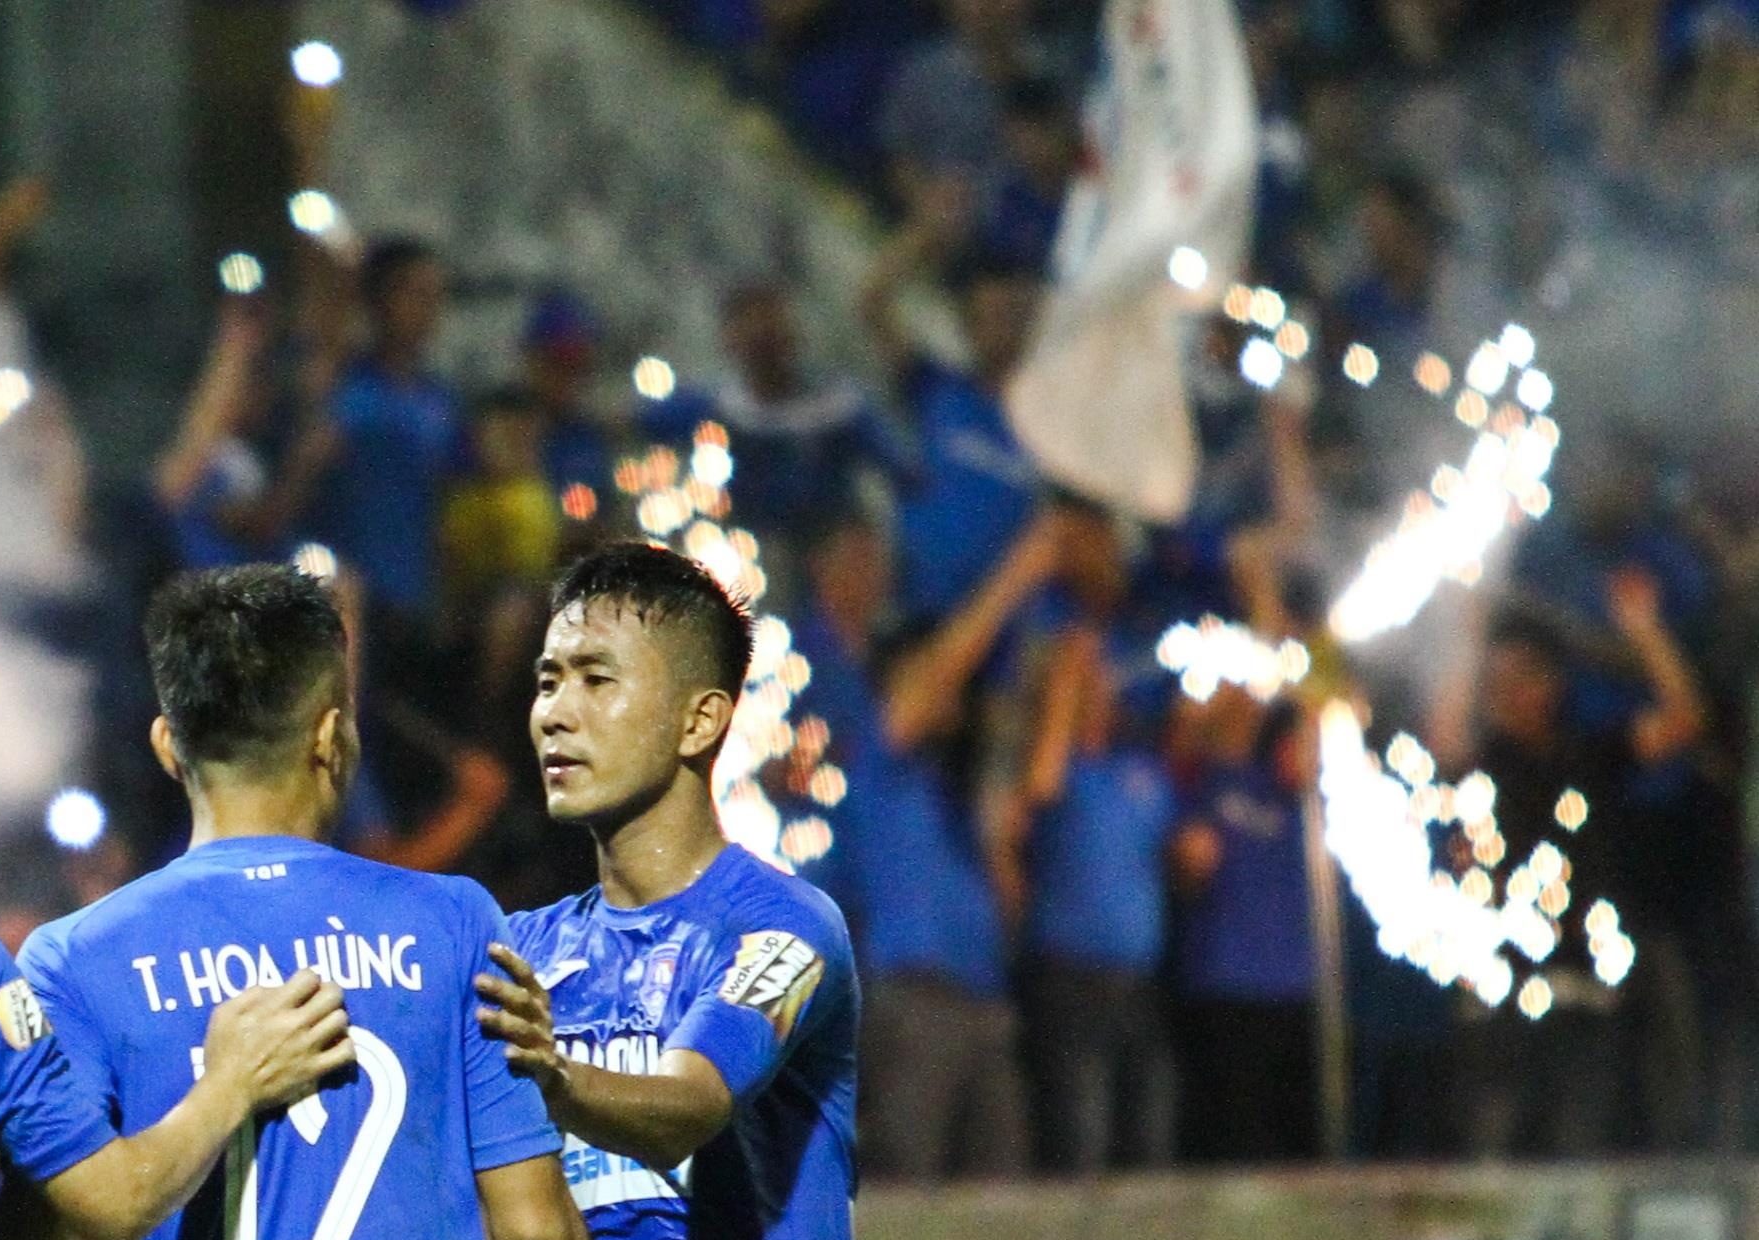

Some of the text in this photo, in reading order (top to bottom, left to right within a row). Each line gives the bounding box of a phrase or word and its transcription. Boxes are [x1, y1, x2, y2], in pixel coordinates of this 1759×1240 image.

[131, 915, 422, 1012] T. HOA HÙNG
